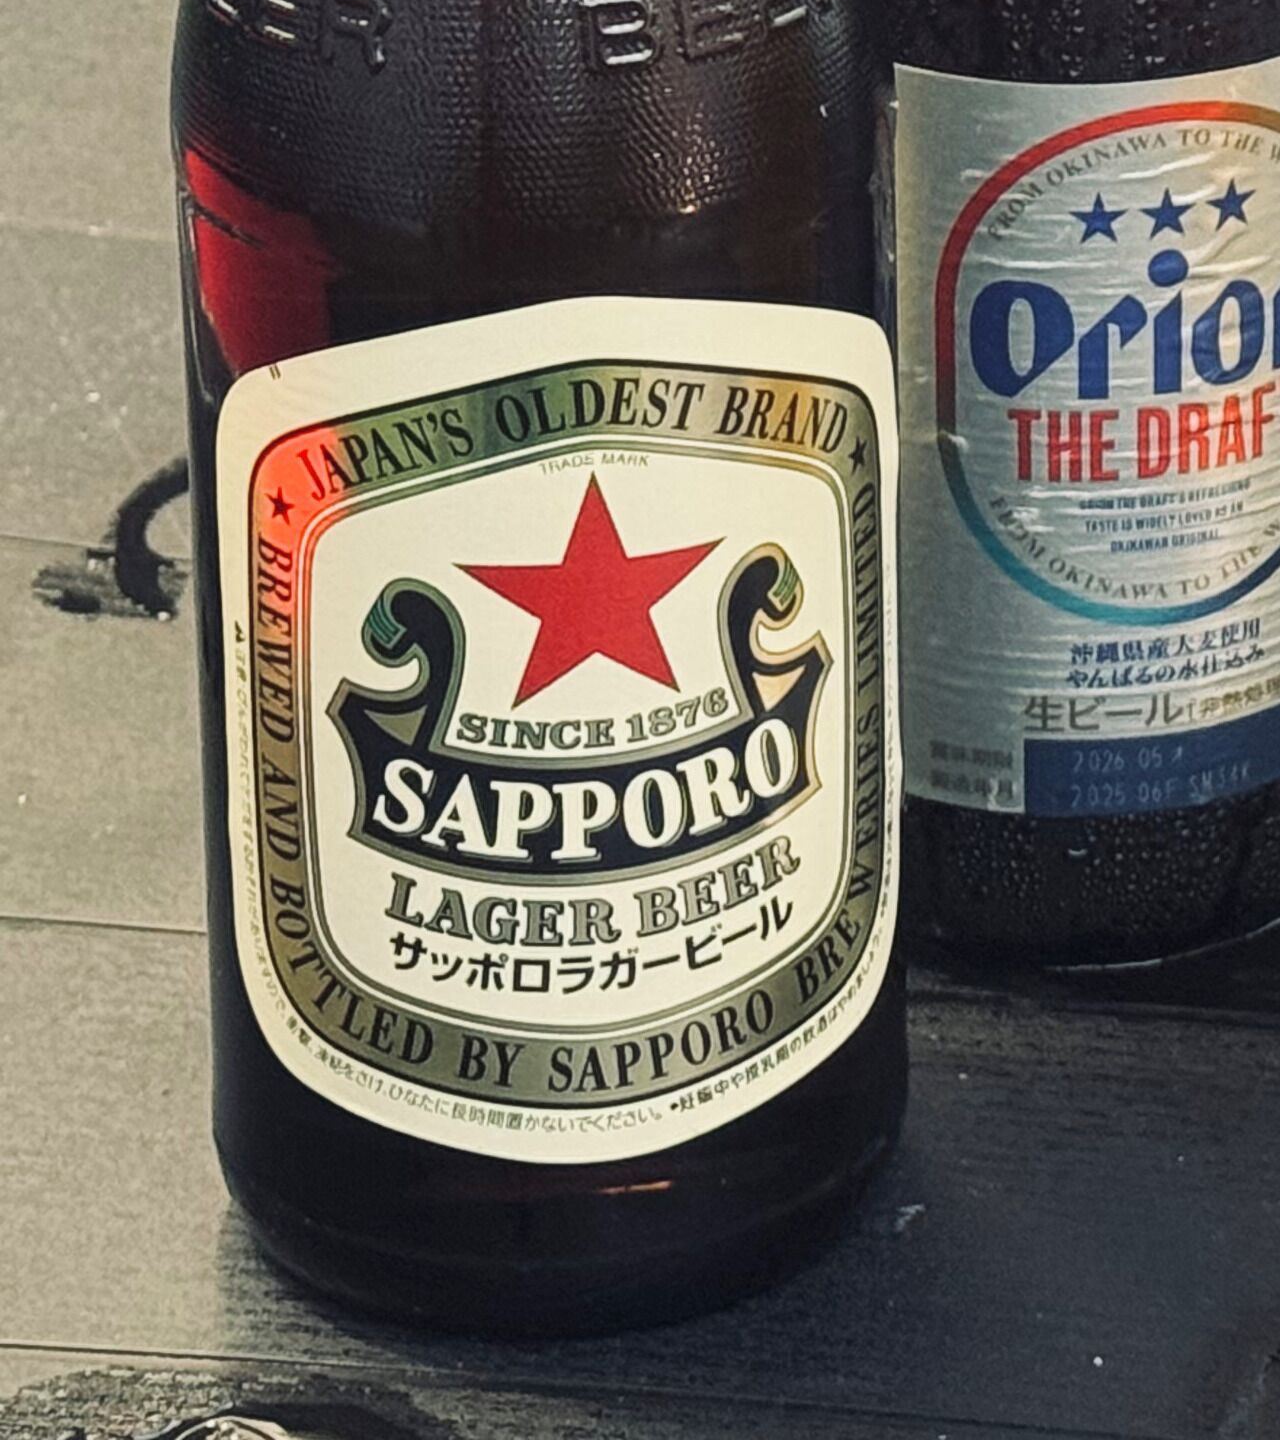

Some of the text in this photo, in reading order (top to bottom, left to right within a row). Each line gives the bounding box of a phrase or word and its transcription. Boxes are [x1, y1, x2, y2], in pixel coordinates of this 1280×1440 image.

[987, 182, 1044, 242] FROM
[1046, 130, 1168, 194] OKINAWA
[1178, 127, 1211, 148] TO
[1219, 130, 1262, 156] THE
[296, 376, 848, 503] JAPAN'S OLDEST BRAND
[538, 454, 650, 476] TRADE MARK
[1007, 408, 1121, 483] THE
[1084, 520, 1119, 534] TASTE
[1135, 514, 1176, 531] WIDELY
[851, 481, 879, 698] LIMITED
[1047, 555, 1168, 601] OKINAWA
[1181, 573, 1212, 597] TO
[256, 531, 296, 744] BREWED
[1066, 644, 1266, 688] やんばるの水仕込み
[1070, 618, 1261, 665] 沖縄県産大麦使用
[456, 686, 730, 750] SINCE 1876
[1023, 692, 1186, 734] 生ビール
[262, 751, 301, 862] AND
[371, 717, 799, 862] SAPPORO
[384, 835, 802, 948] LAGER BEER
[269, 873, 435, 1066] BOTTLED
[389, 895, 795, 996] サッポロラガービール
[457, 1033, 526, 1089] BY
[547, 988, 775, 1094] SAPPORO
